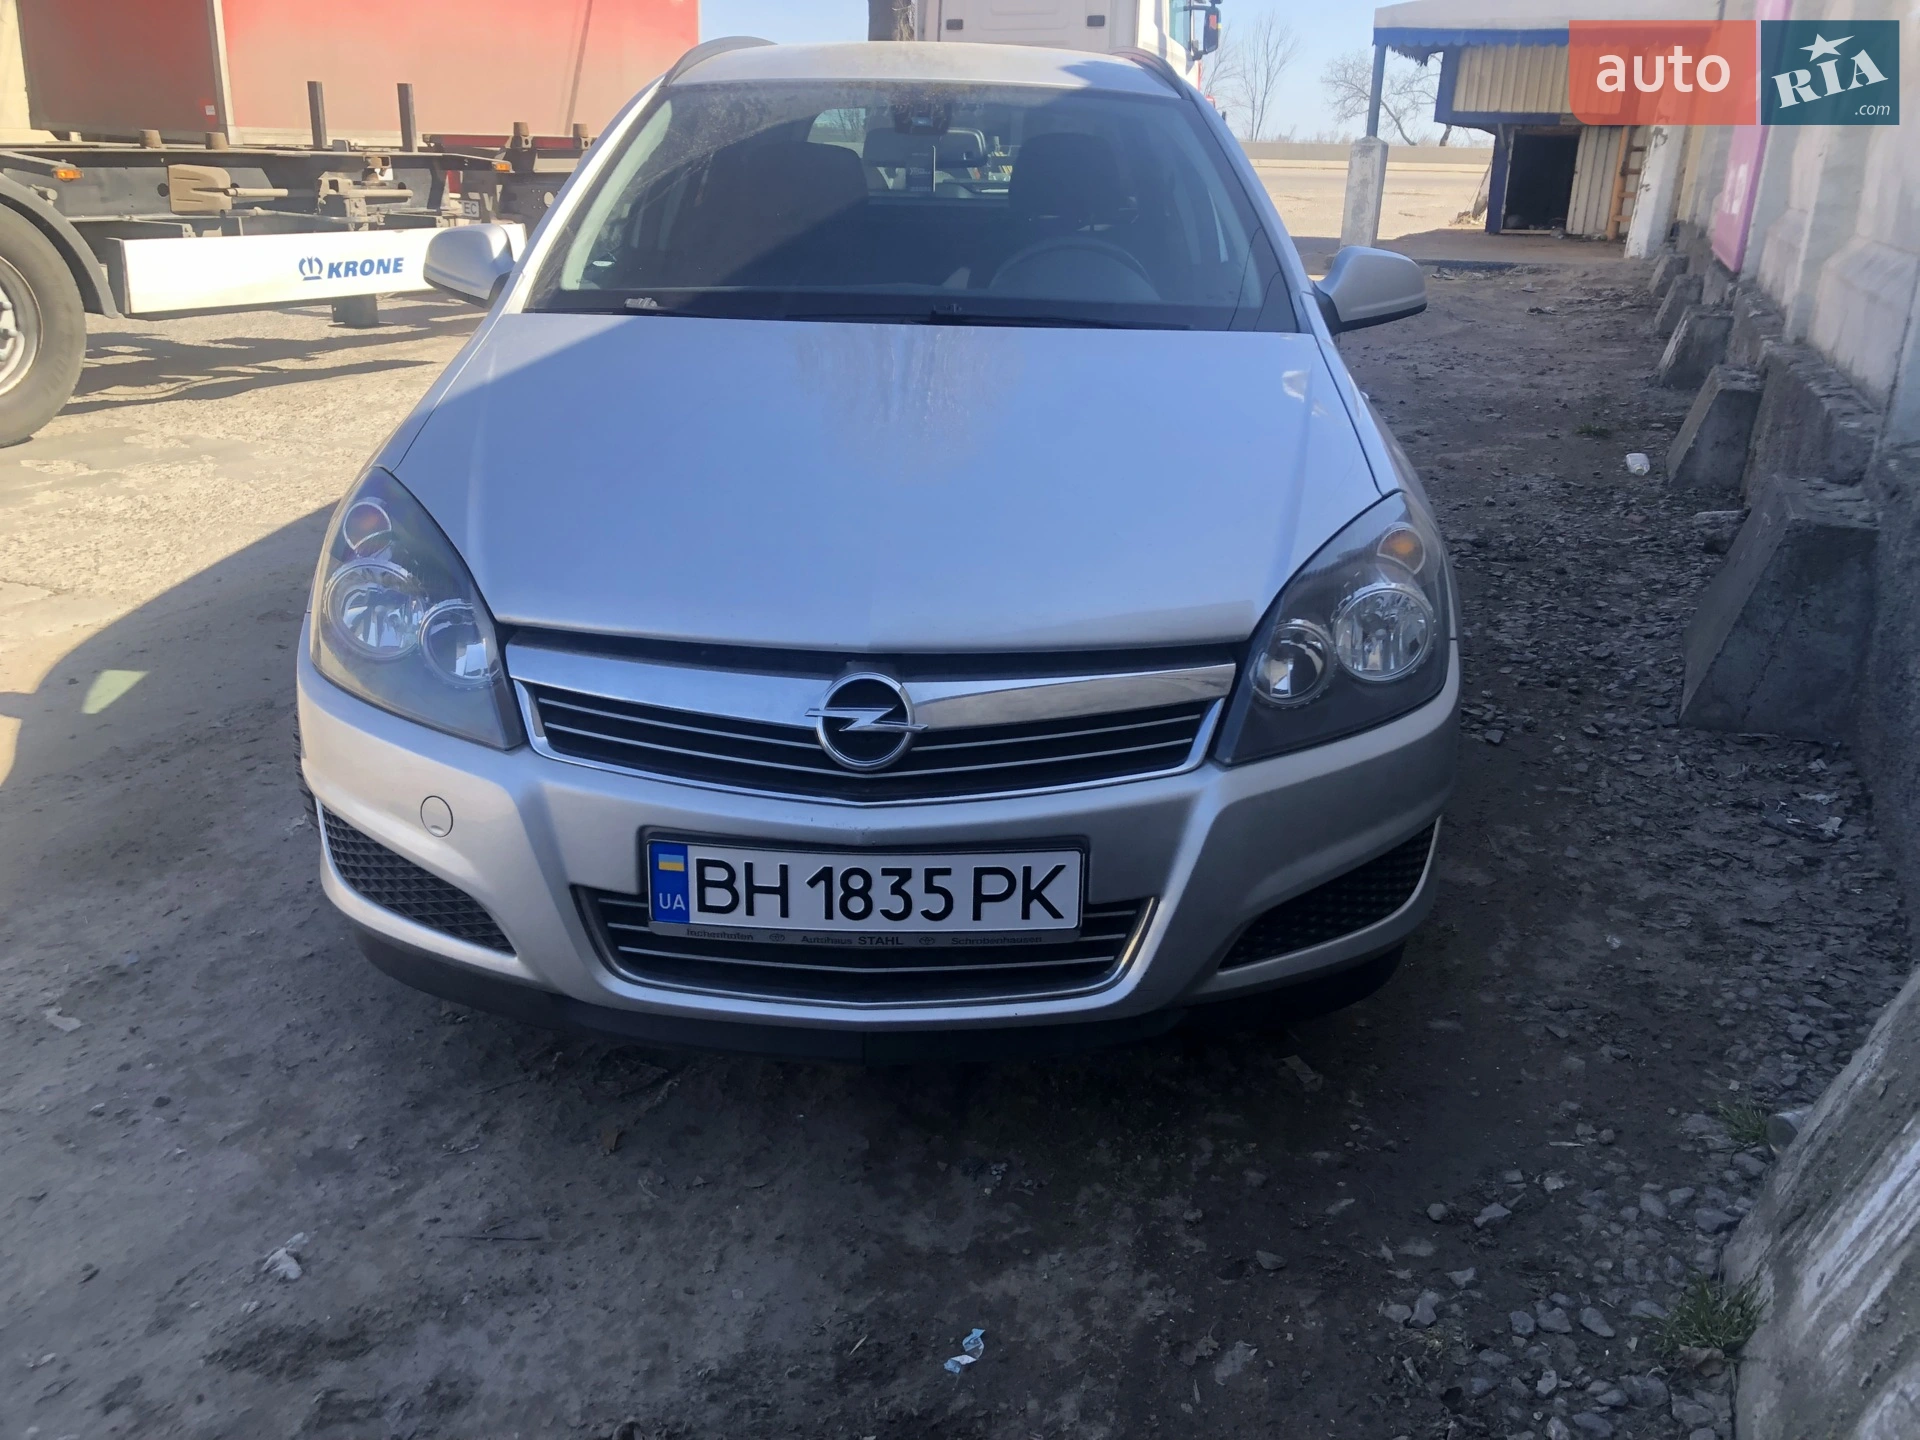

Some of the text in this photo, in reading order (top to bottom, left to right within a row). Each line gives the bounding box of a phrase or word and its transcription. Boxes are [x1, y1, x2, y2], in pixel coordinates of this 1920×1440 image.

[327, 257, 404, 279] KRONE
[695, 857, 1067, 922] BH 1835 PK
[658, 892, 686, 911] UA
[801, 935, 853, 945] Autohaus
[858, 936, 904, 946] STAHL
